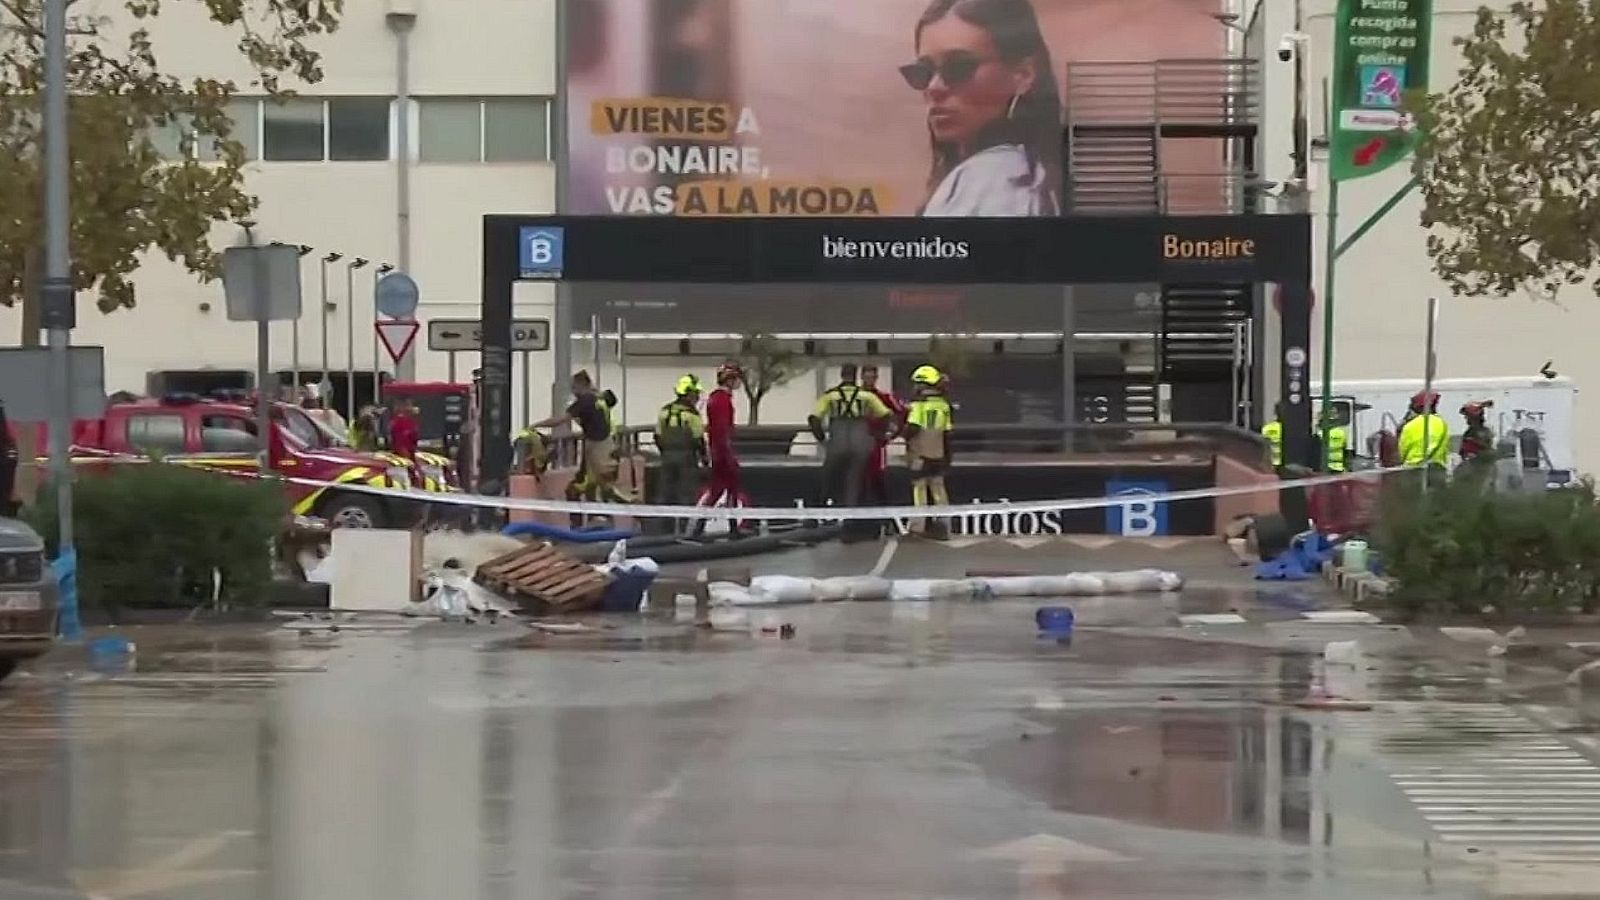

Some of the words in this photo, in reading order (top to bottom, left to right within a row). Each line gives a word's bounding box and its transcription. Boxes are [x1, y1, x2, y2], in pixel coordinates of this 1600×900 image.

[1351, 16, 1417, 31] recogida
[1349, 36, 1417, 49] compras
[1357, 52, 1407, 65] online
[605, 106, 727, 134] VIENES
[735, 107, 760, 134] A
[605, 145, 769, 179] BONAIRE,
[606, 186, 675, 214] VAS
[683, 187, 707, 214] A
[717, 187, 760, 214] LA
[769, 187, 880, 214] MODA
[531, 238, 552, 264] B
[823, 235, 970, 258] bienvenidos
[1163, 234, 1256, 258] Bonaire
